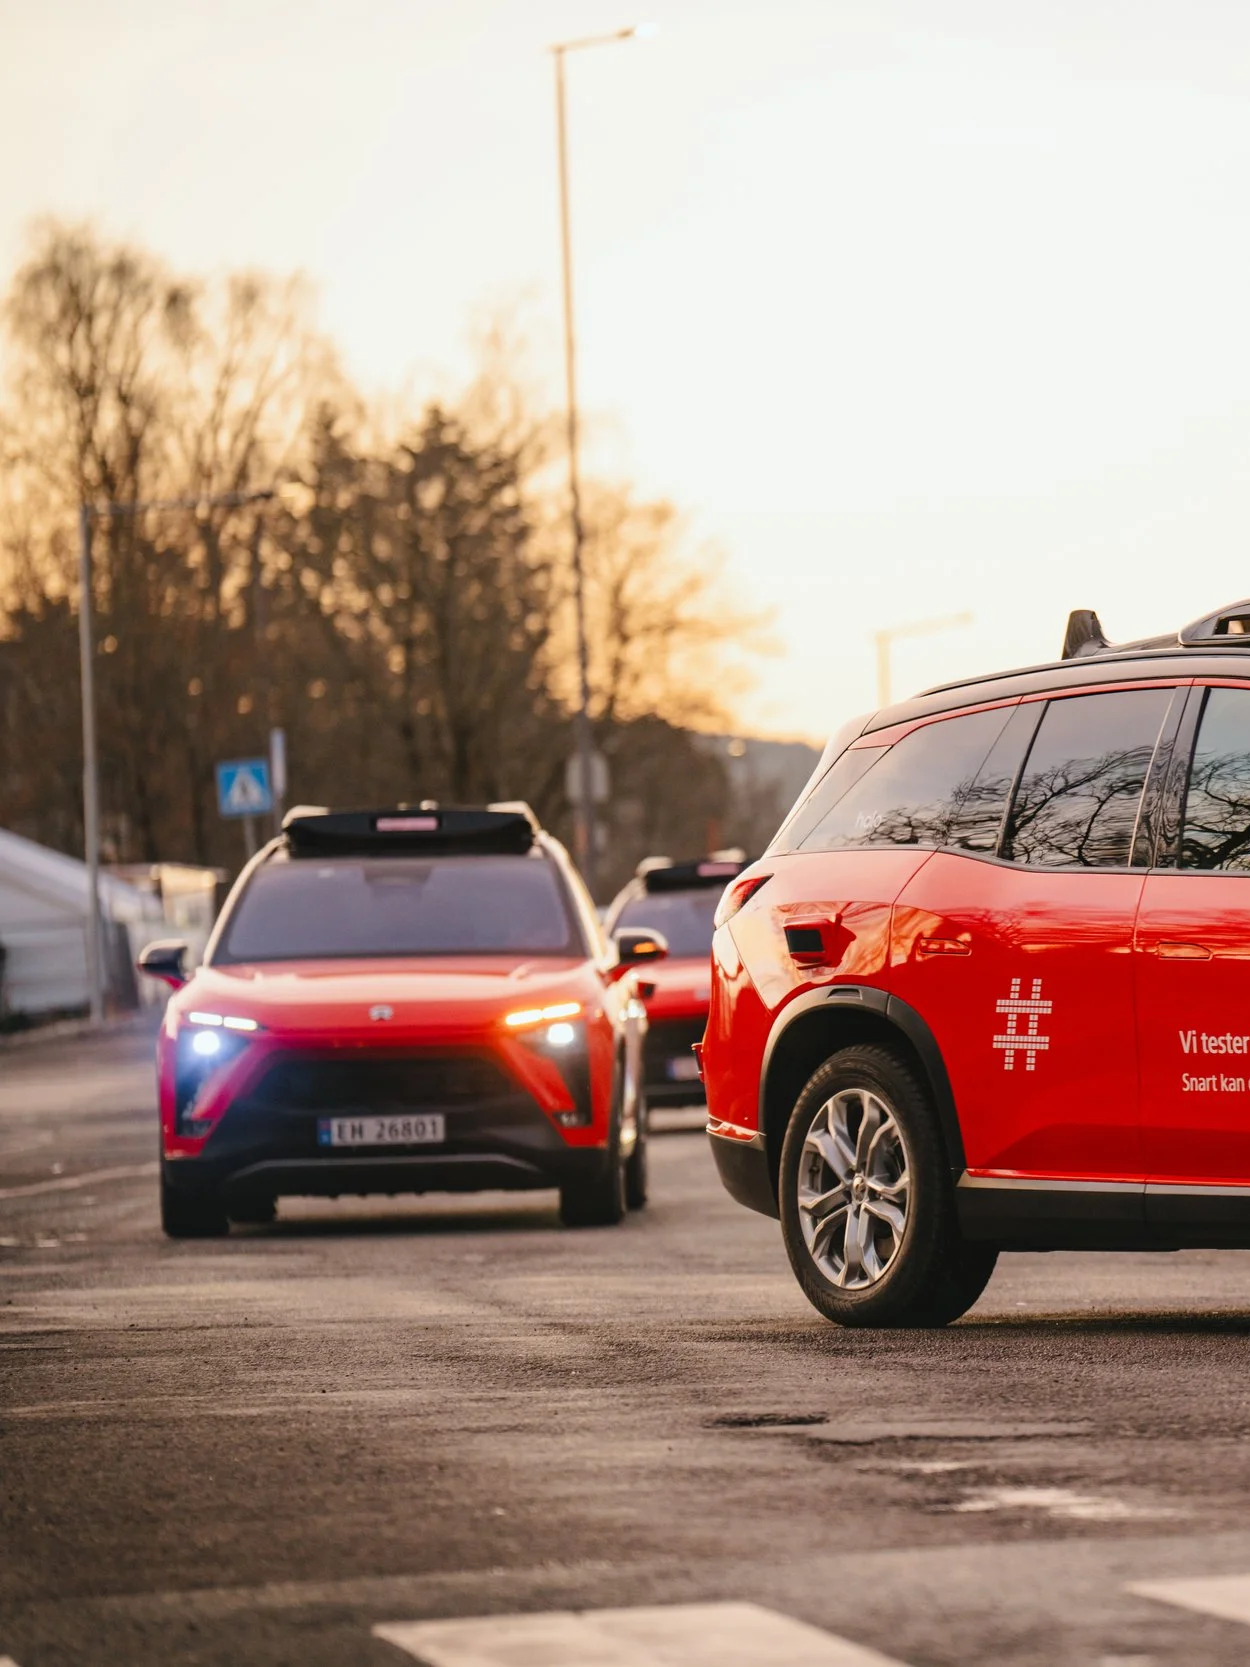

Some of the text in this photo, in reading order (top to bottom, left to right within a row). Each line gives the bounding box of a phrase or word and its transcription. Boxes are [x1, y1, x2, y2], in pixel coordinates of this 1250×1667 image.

[1179, 1030, 1198, 1054] Vi
[1201, 1032, 1250, 1055] tester
[1182, 1073, 1217, 1092] Snart
[1220, 1074, 1245, 1092] kan
[337, 1121, 364, 1141] EH
[375, 1117, 438, 1140] 26801
